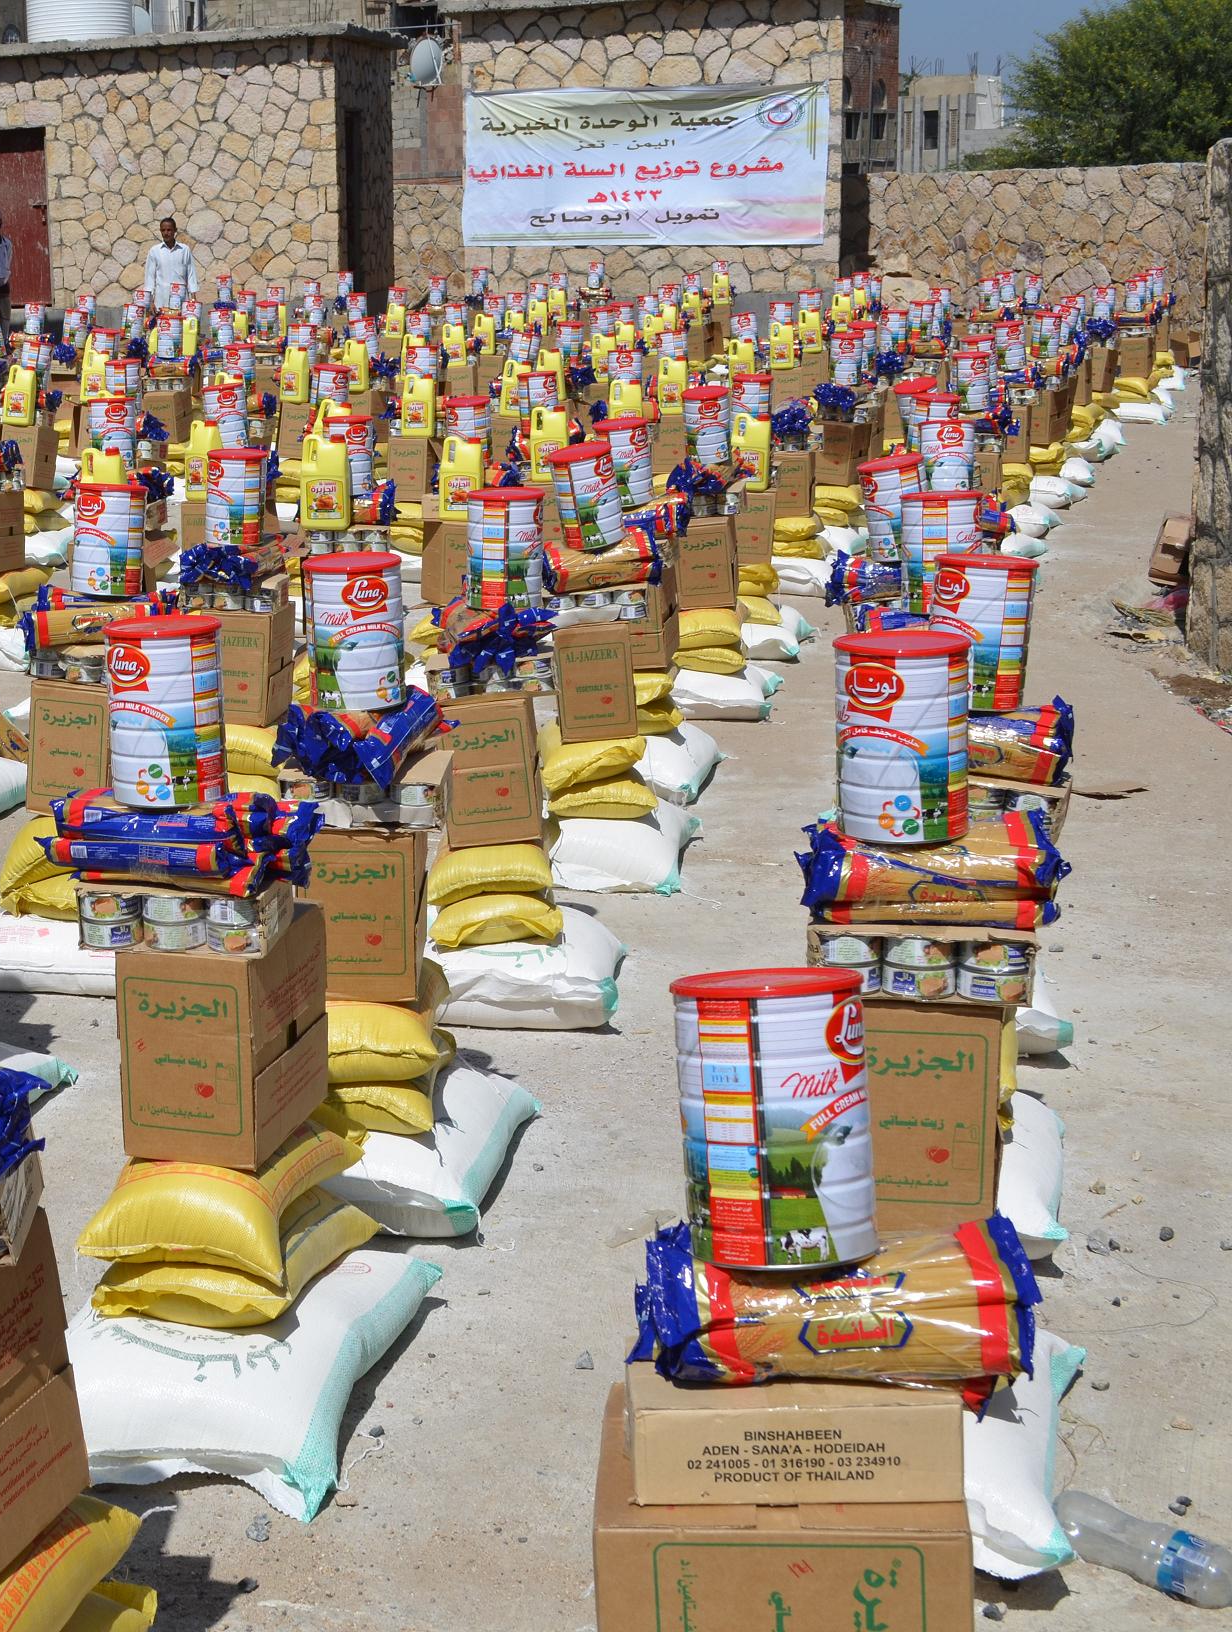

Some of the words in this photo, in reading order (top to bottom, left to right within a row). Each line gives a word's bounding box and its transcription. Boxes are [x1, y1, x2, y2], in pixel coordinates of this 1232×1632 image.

[480, 116, 569, 136] الخيرية
[579, 114, 658, 132] الوحدة
[669, 112, 739, 130] جمعية
[573, 140, 605, 151] تعز
[626, 138, 675, 150] اليمن
[562, 161, 625, 178] السلة
[635, 160, 700, 182] توزيع
[710, 156, 784, 179] مشروع
[655, 208, 719, 225] تمويل
[345, 579, 383, 605] Luna
[936, 570, 966, 597] لونا
[319, 611, 350, 627] Milk
[331, 633, 345, 644] FULL
[344, 627, 367, 638] CREAM
[107, 648, 144, 680] Luna
[849, 669, 898, 704] لونا
[41, 708, 98, 728] الجزيرة
[140, 705, 170, 722] POWDER
[452, 730, 516, 751] الجزيرة
[316, 860, 397, 885] الجزيرة
[137, 990, 229, 1025] الجزيرة
[780, 1068, 839, 1100] Milk
[810, 1111, 833, 1131] FULL
[831, 1091, 862, 1115] CREAM
[878, 1116, 920, 1132] نباتي
[921, 1117, 946, 1131] زيت
[816, 1316, 896, 1347] المائدة
[744, 1429, 843, 1442] BINSHAHBEEN
[702, 1443, 741, 1456] ADEN
[752, 1442, 802, 1456] SANA'A
[813, 1442, 885, 1455] HODEIDAH
[687, 1459, 704, 1470] 02
[706, 1458, 751, 1470] 241005
[762, 1458, 776, 1469] 01
[778, 1457, 826, 1470] 316190
[838, 1457, 853, 1468] 03
[855, 1456, 901, 1468] 234910
[714, 1471, 781, 1483] PRODUCT
[784, 1471, 803, 1483] OF
[806, 1470, 875, 1482] THAILAND
